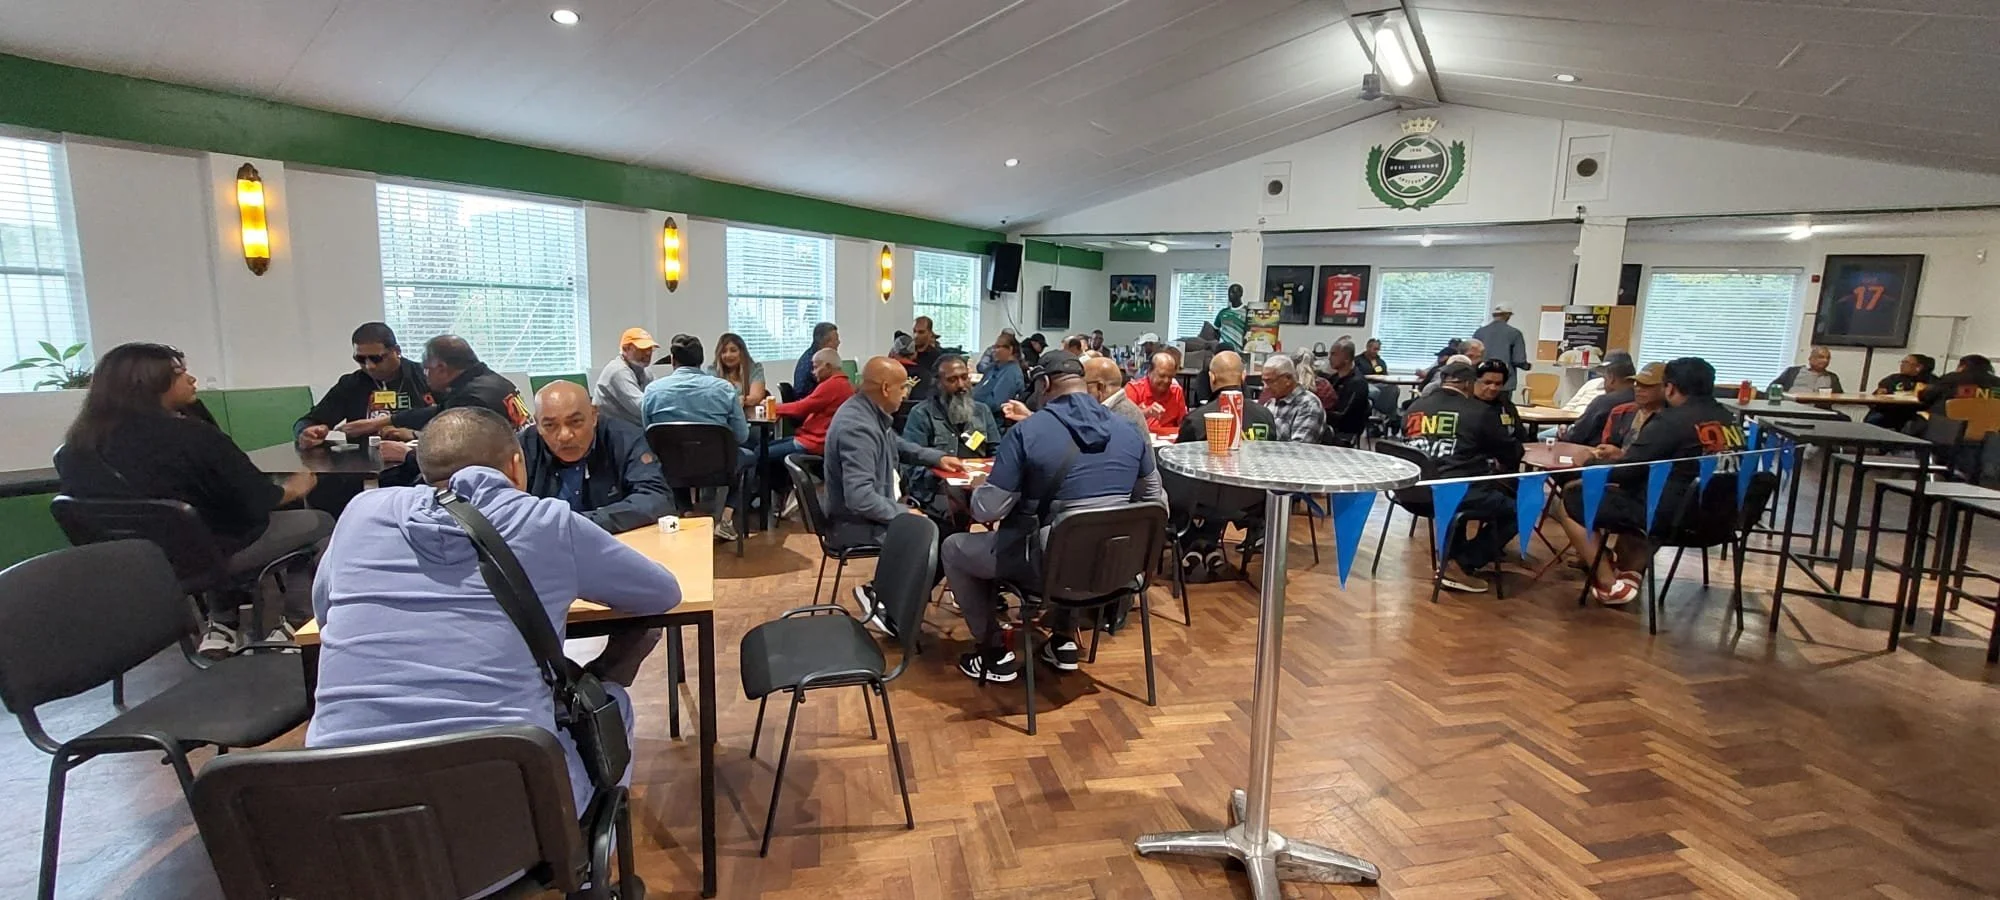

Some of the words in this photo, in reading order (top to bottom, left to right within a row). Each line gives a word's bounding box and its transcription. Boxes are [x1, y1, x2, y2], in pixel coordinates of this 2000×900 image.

[1283, 289, 1293, 306] 5
[1332, 290, 1352, 309] 27
[1854, 286, 1885, 310] 17
